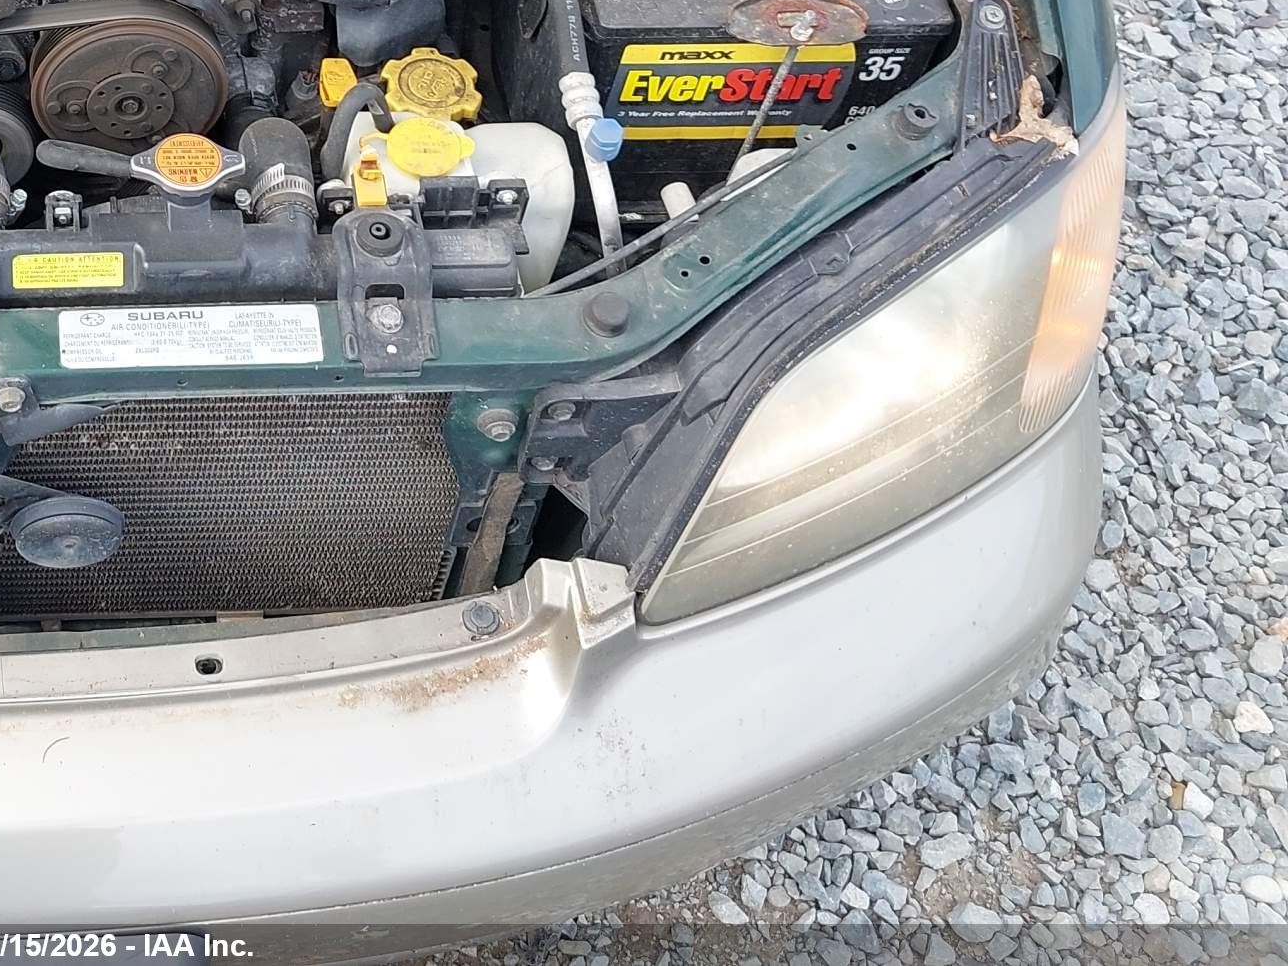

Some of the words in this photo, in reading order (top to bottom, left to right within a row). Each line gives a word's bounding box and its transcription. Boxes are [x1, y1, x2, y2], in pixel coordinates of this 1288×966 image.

[659, 50, 736, 61] maxx
[858, 56, 906, 81] 35
[618, 67, 841, 103] EverStart
[677, 110, 744, 118] Replacement
[127, 310, 203, 321] SUBARU
